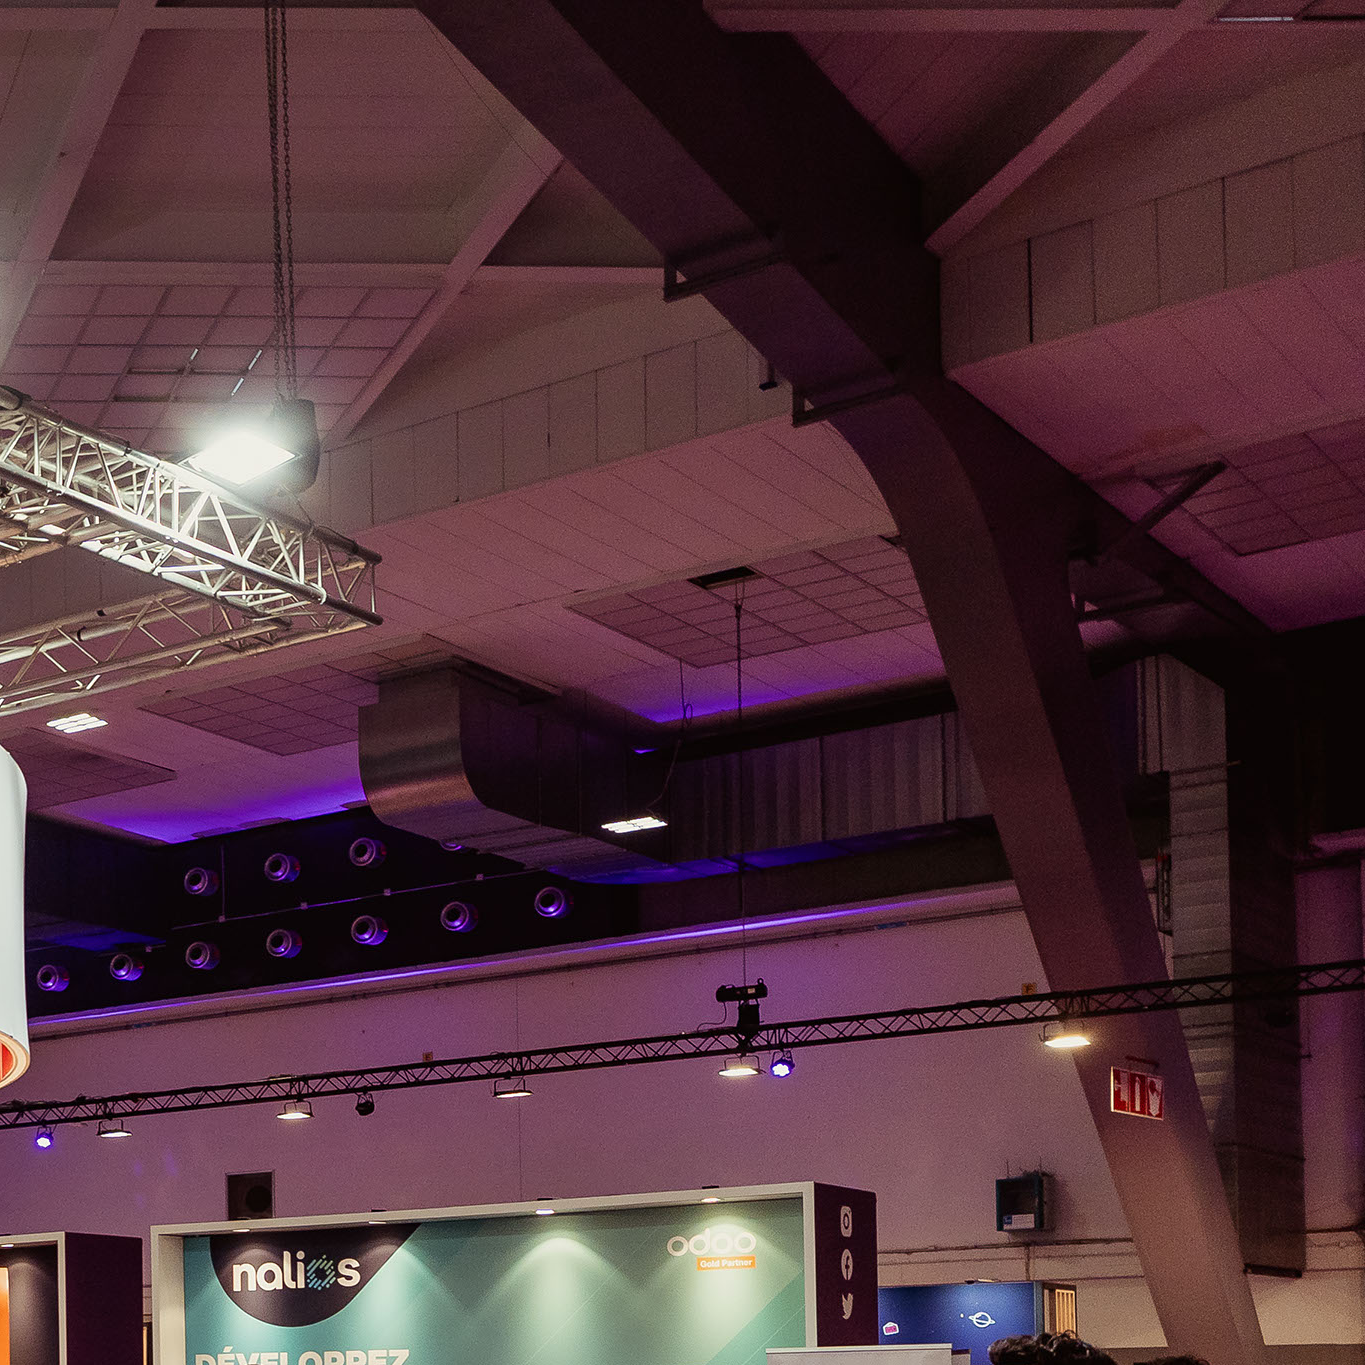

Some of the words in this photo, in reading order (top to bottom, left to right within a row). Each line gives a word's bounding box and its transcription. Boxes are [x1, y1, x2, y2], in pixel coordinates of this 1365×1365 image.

[667, 1227, 757, 1257] odoo
[232, 1250, 361, 1292] nalios
[699, 1259, 720, 1268] Gold
[721, 1258, 753, 1268] Partner
